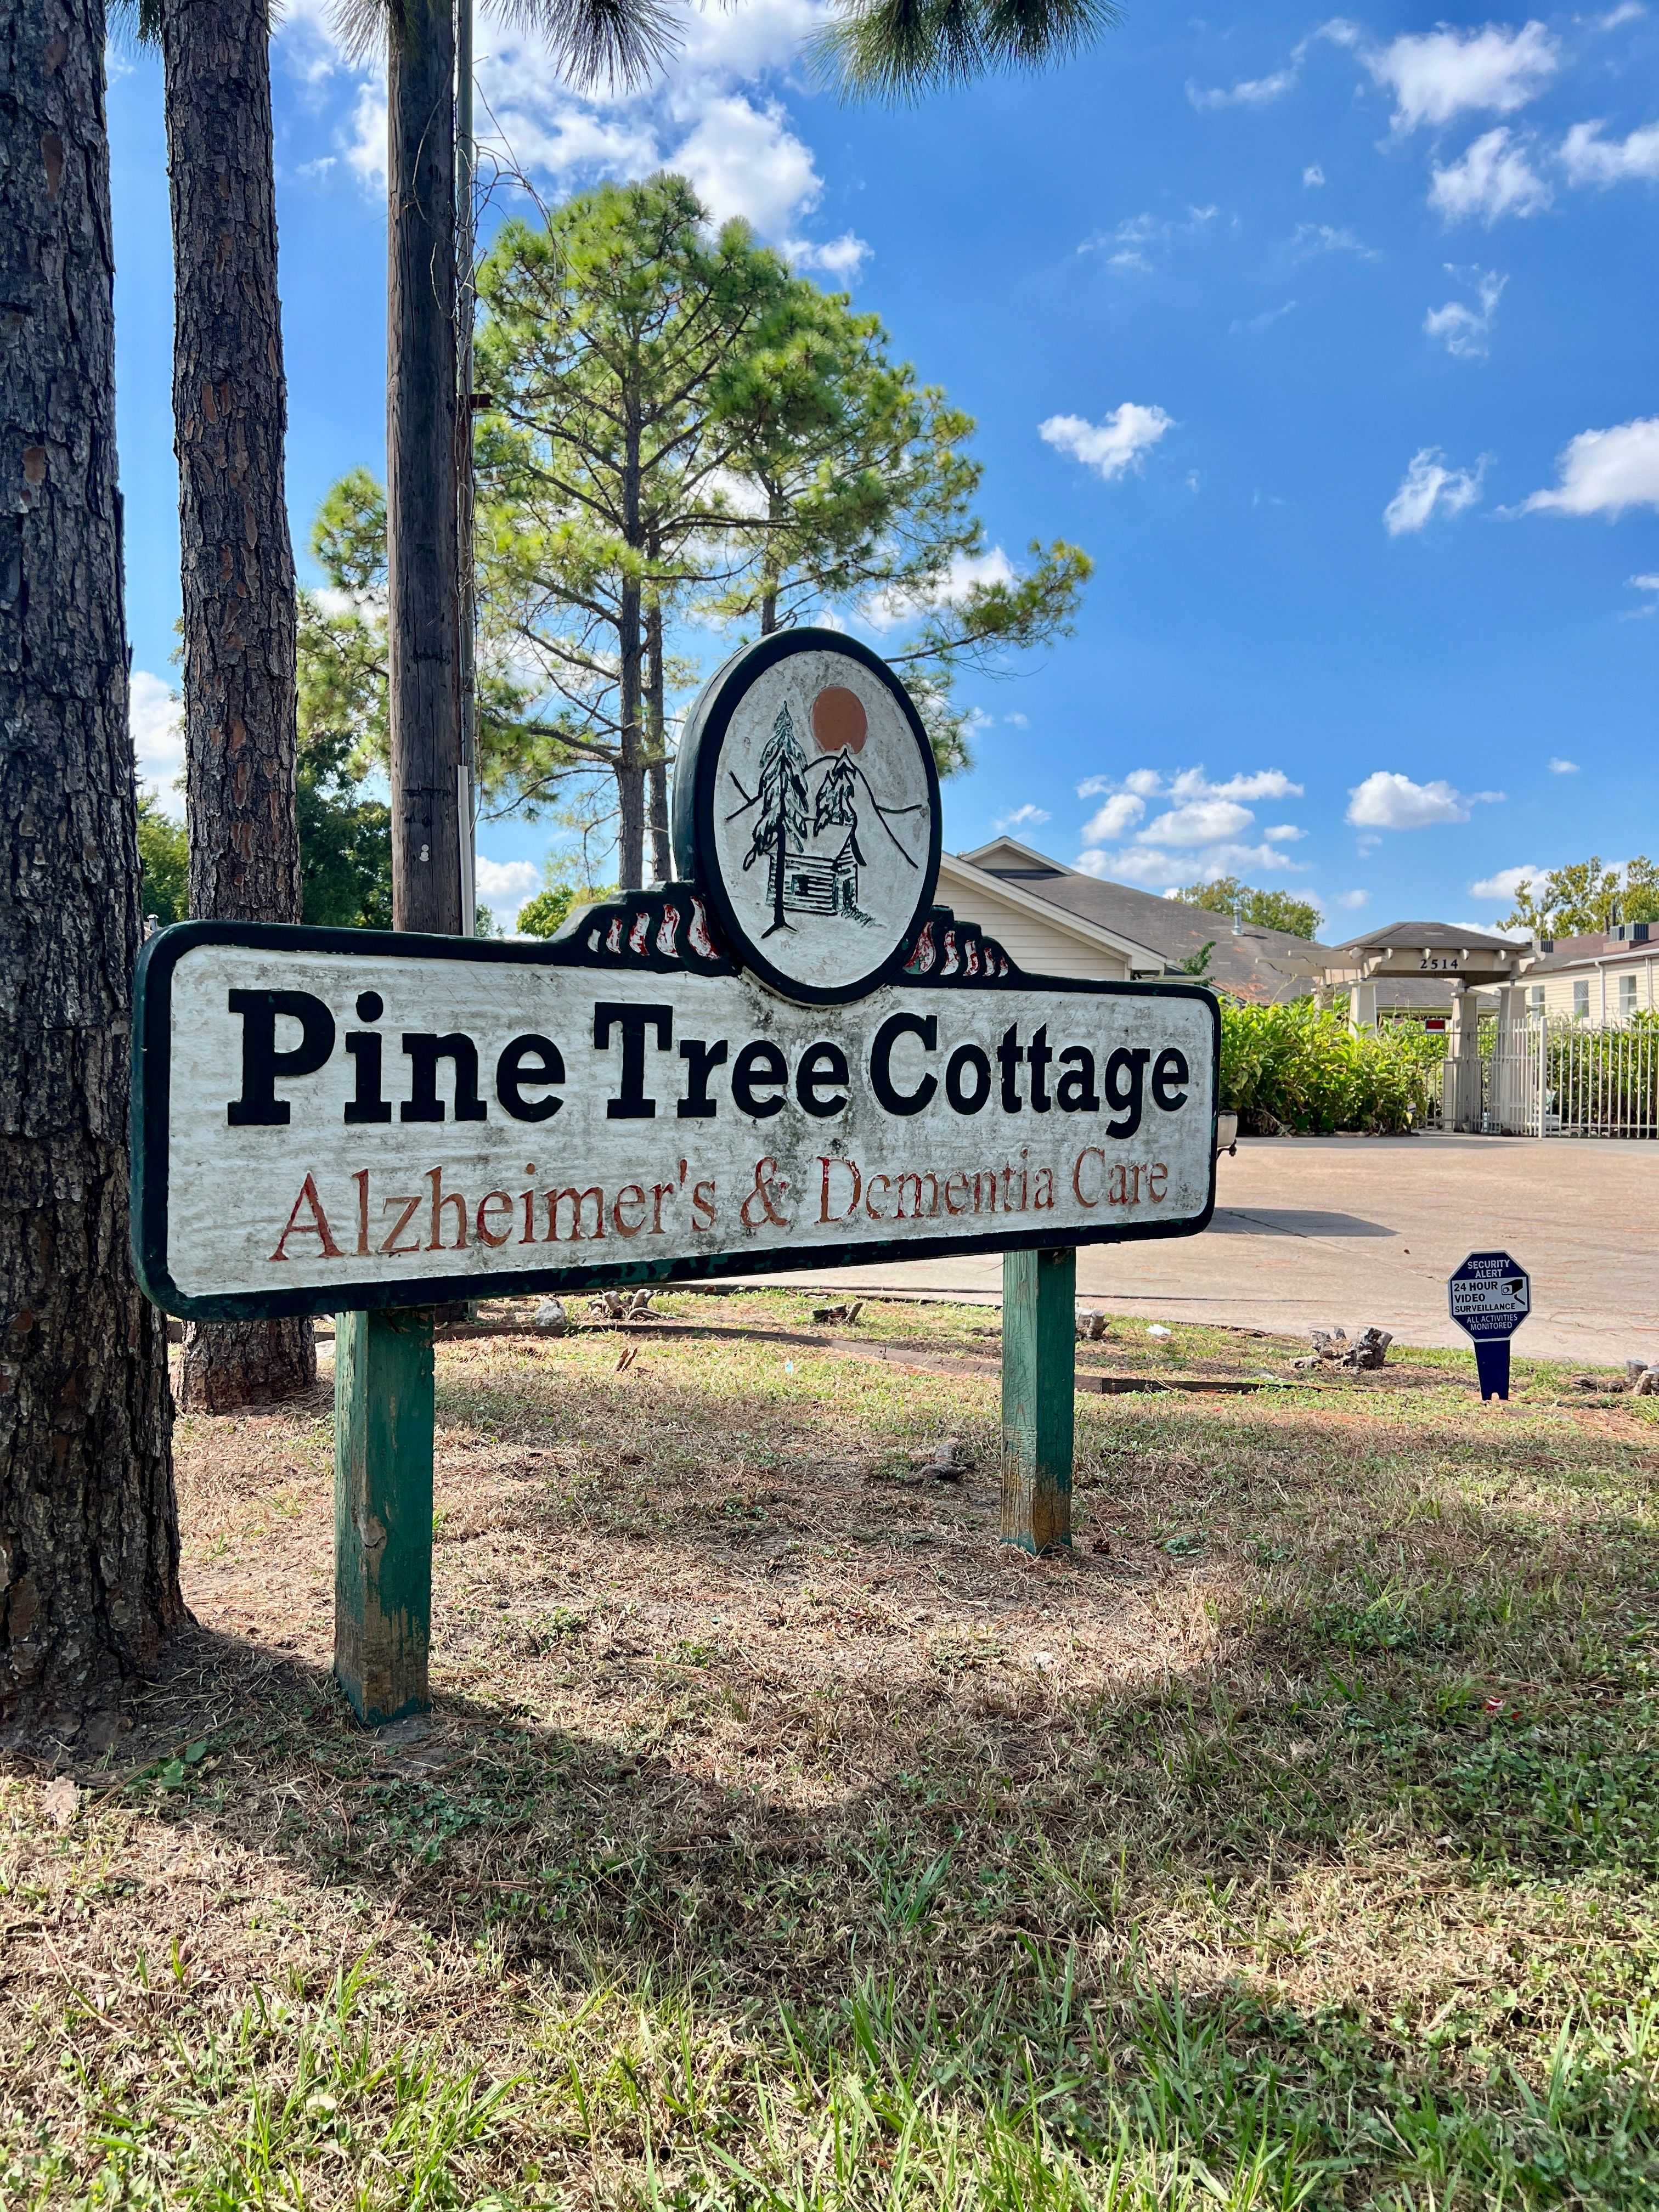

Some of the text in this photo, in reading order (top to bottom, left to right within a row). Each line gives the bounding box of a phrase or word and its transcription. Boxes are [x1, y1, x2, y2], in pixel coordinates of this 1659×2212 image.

[1420, 958, 1458, 969] 2514
[228, 989, 1189, 1139] Pine Tree Cottage
[268, 1147, 1168, 1261] Alzheimer's & Dementia Care
[1468, 1260, 1510, 1269] SECURITY
[1475, 1269, 1503, 1278] ALERT
[1454, 1281, 1498, 1291] 24 HOUR
[1454, 1293, 1486, 1303] VIDEO
[1455, 1303, 1515, 1312] SURVEILLANCE
[1481, 1314, 1517, 1323] ACTIVITIES
[1470, 1322, 1513, 1330] MONITORED
